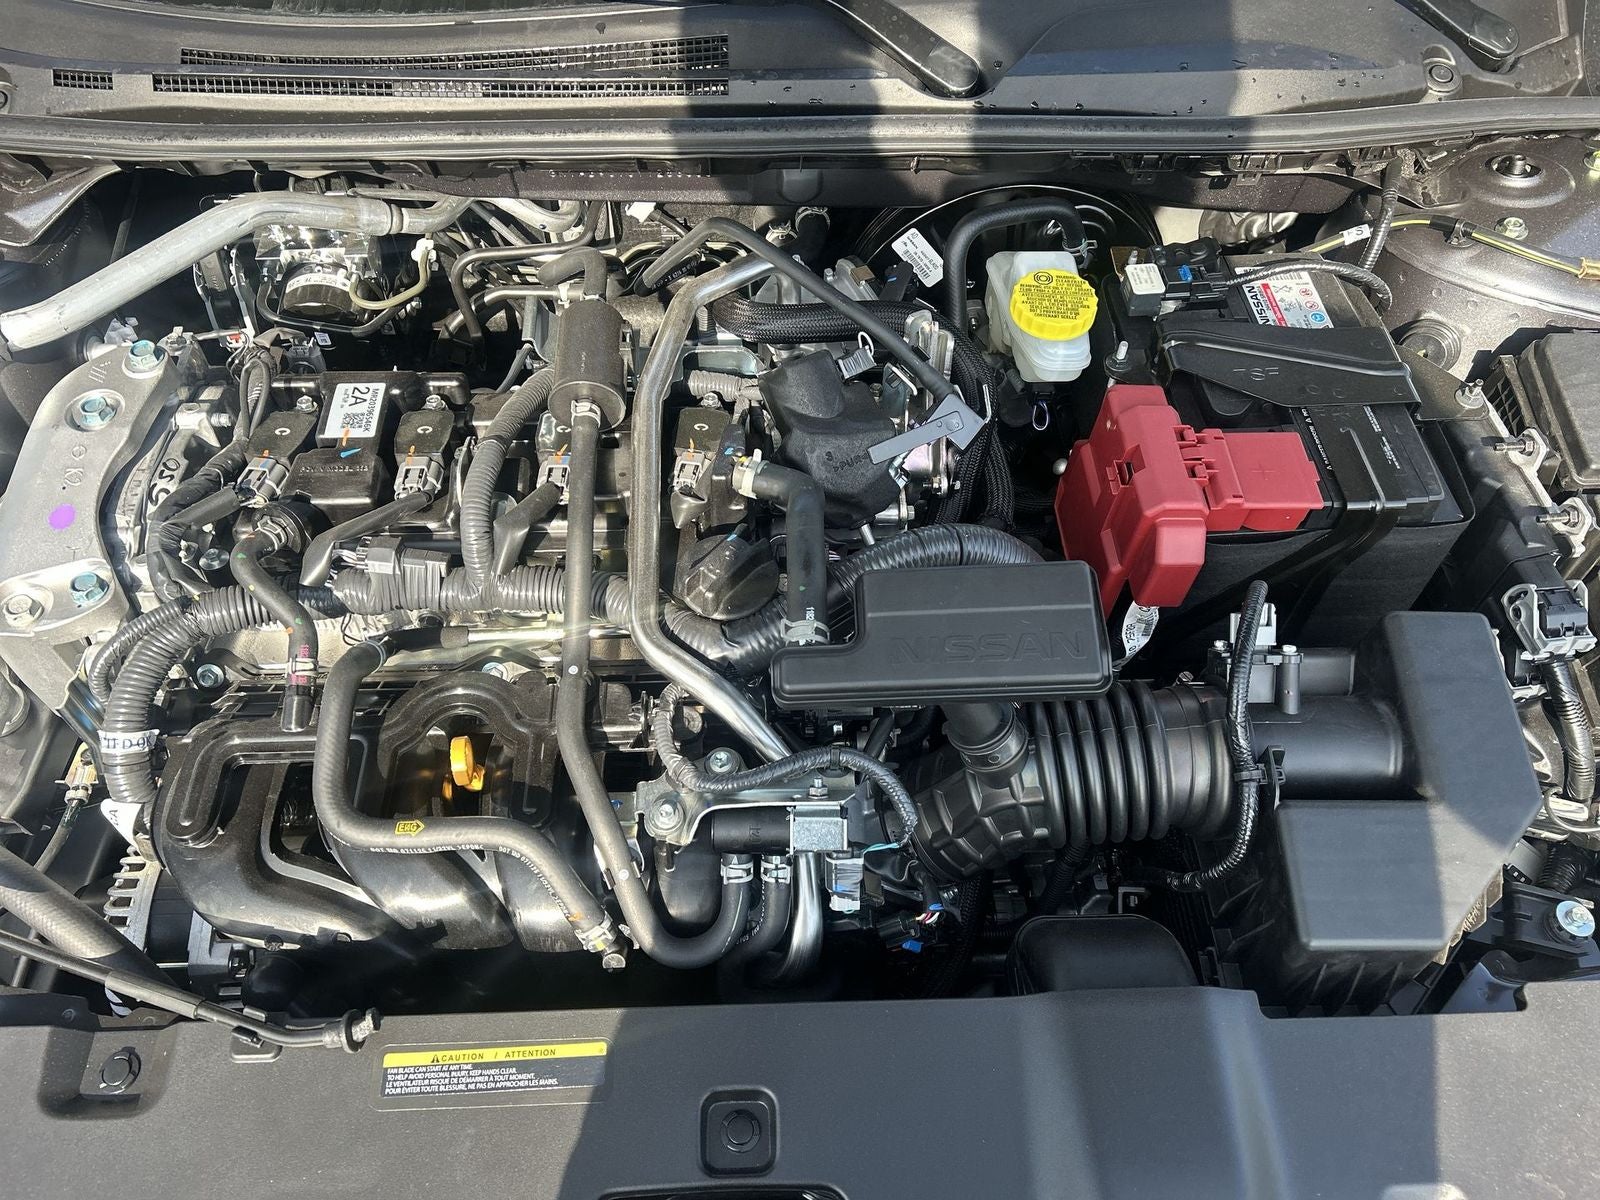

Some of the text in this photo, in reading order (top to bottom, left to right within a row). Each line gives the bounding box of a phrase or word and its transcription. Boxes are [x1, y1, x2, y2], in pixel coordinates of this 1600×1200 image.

[1246, 286, 1270, 325] NISSAN
[348, 386, 370, 406] 2A
[892, 632, 1088, 665] NISSAN
[441, 1052, 484, 1062] CAUTION
[504, 1049, 556, 1058] ATTENTION
[393, 1079, 429, 1087] VENTILATEUR
